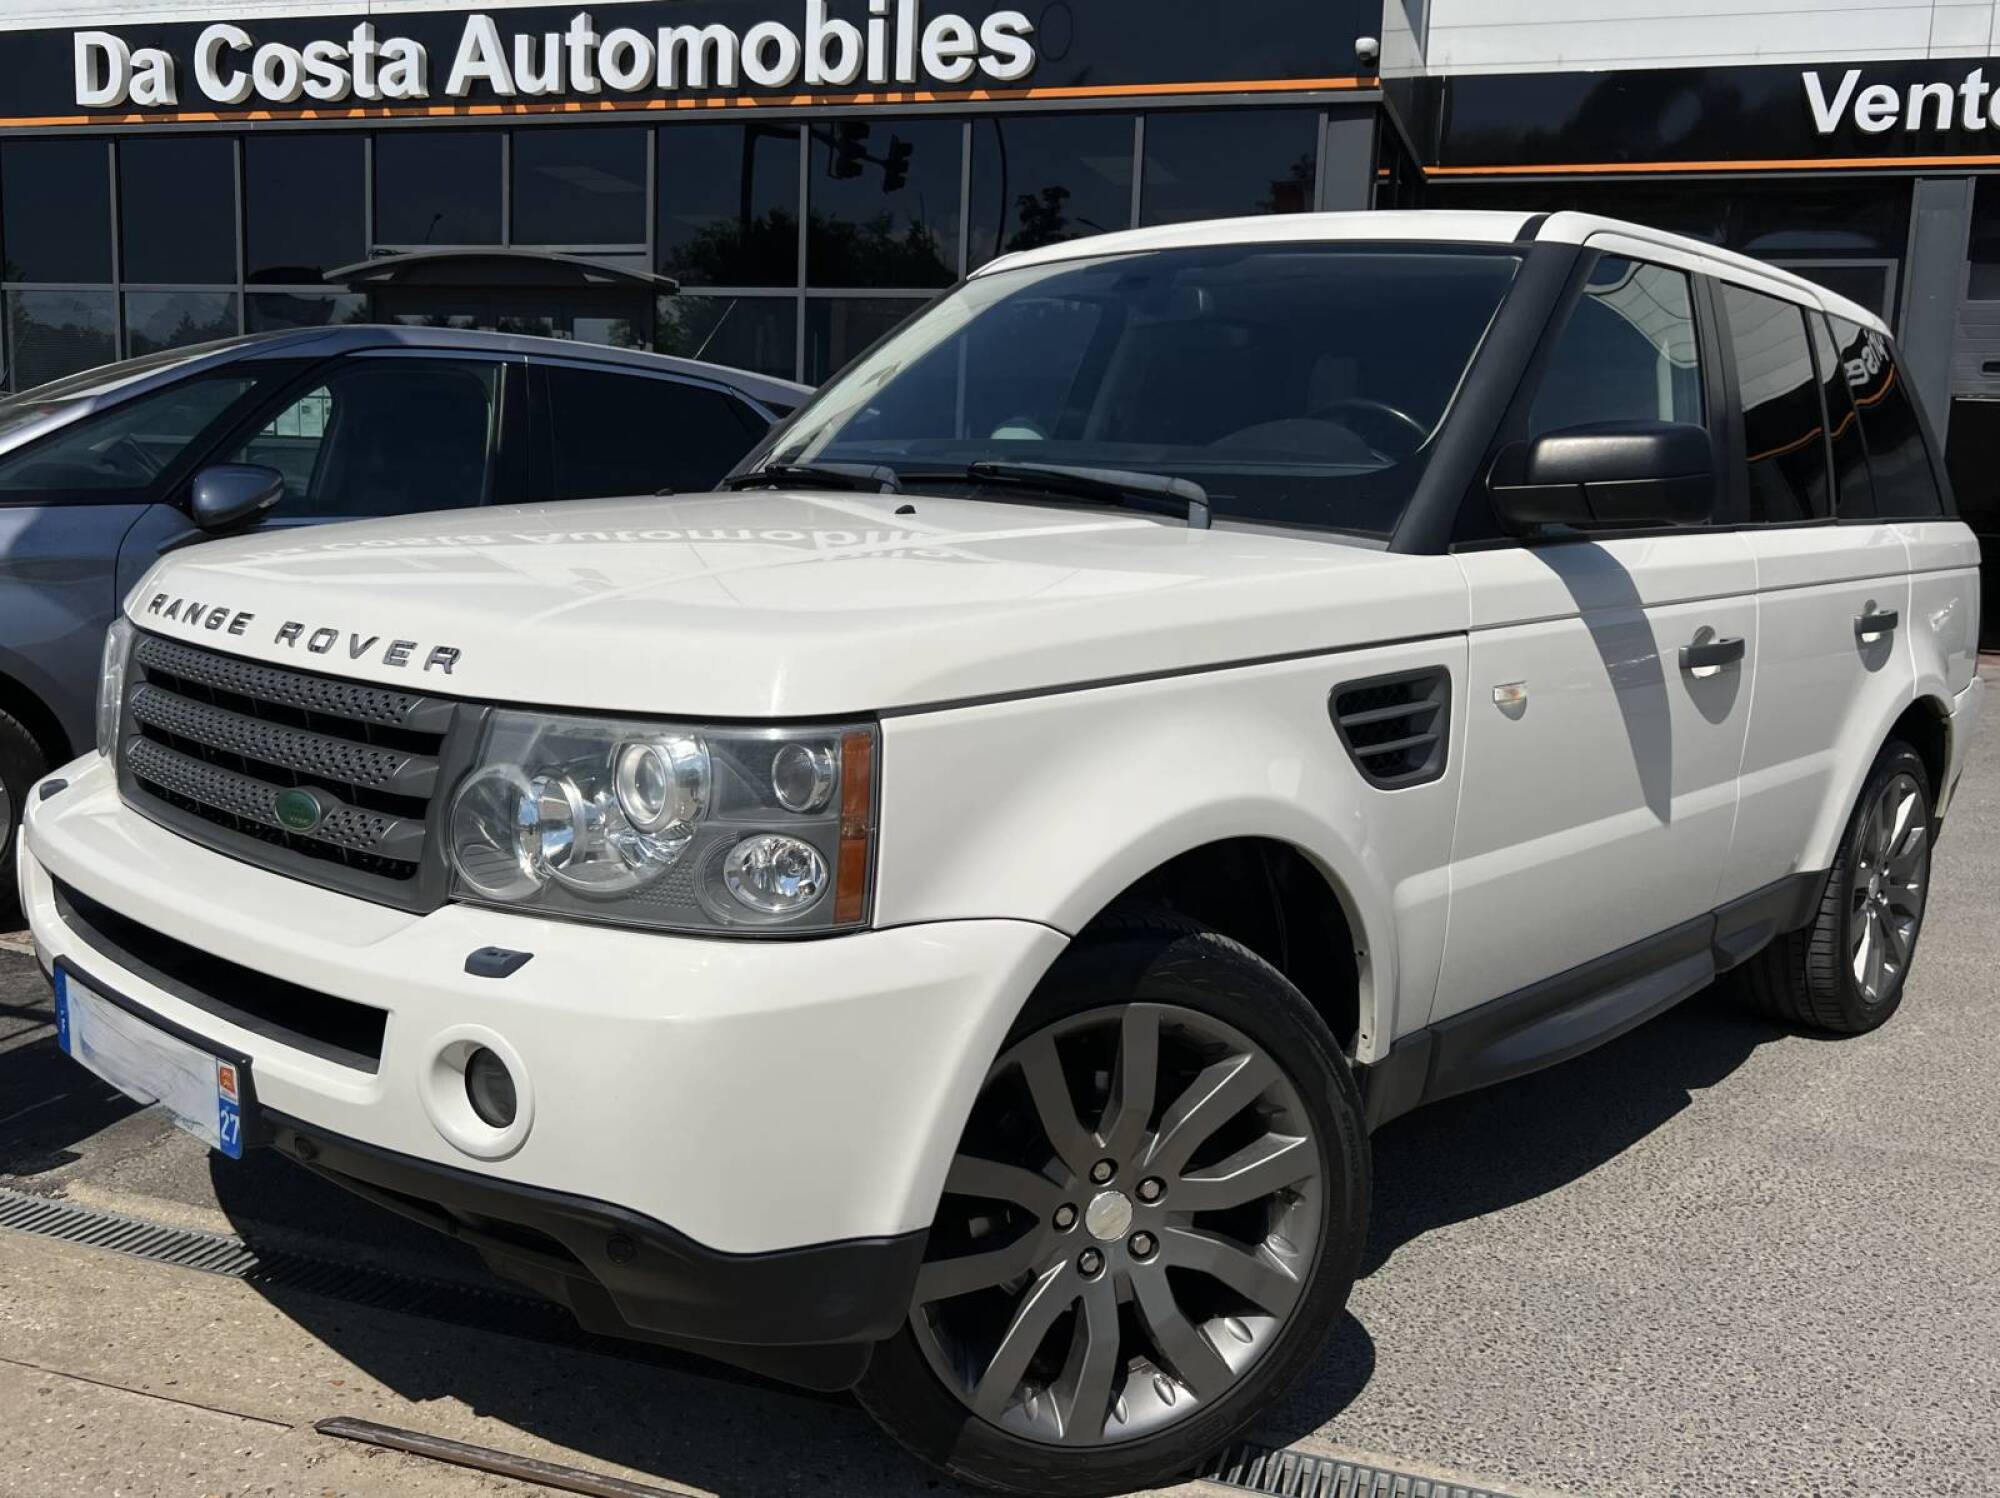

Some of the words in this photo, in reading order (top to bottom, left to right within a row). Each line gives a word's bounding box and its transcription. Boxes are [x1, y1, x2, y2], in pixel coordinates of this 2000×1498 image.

[74, 30, 178, 107] Da
[194, 21, 430, 103] Costa
[444, 0, 1035, 97] Automobiles
[147, 593, 254, 635] RANGE
[274, 621, 461, 675] ROVER
[220, 1110, 240, 1145] 27
